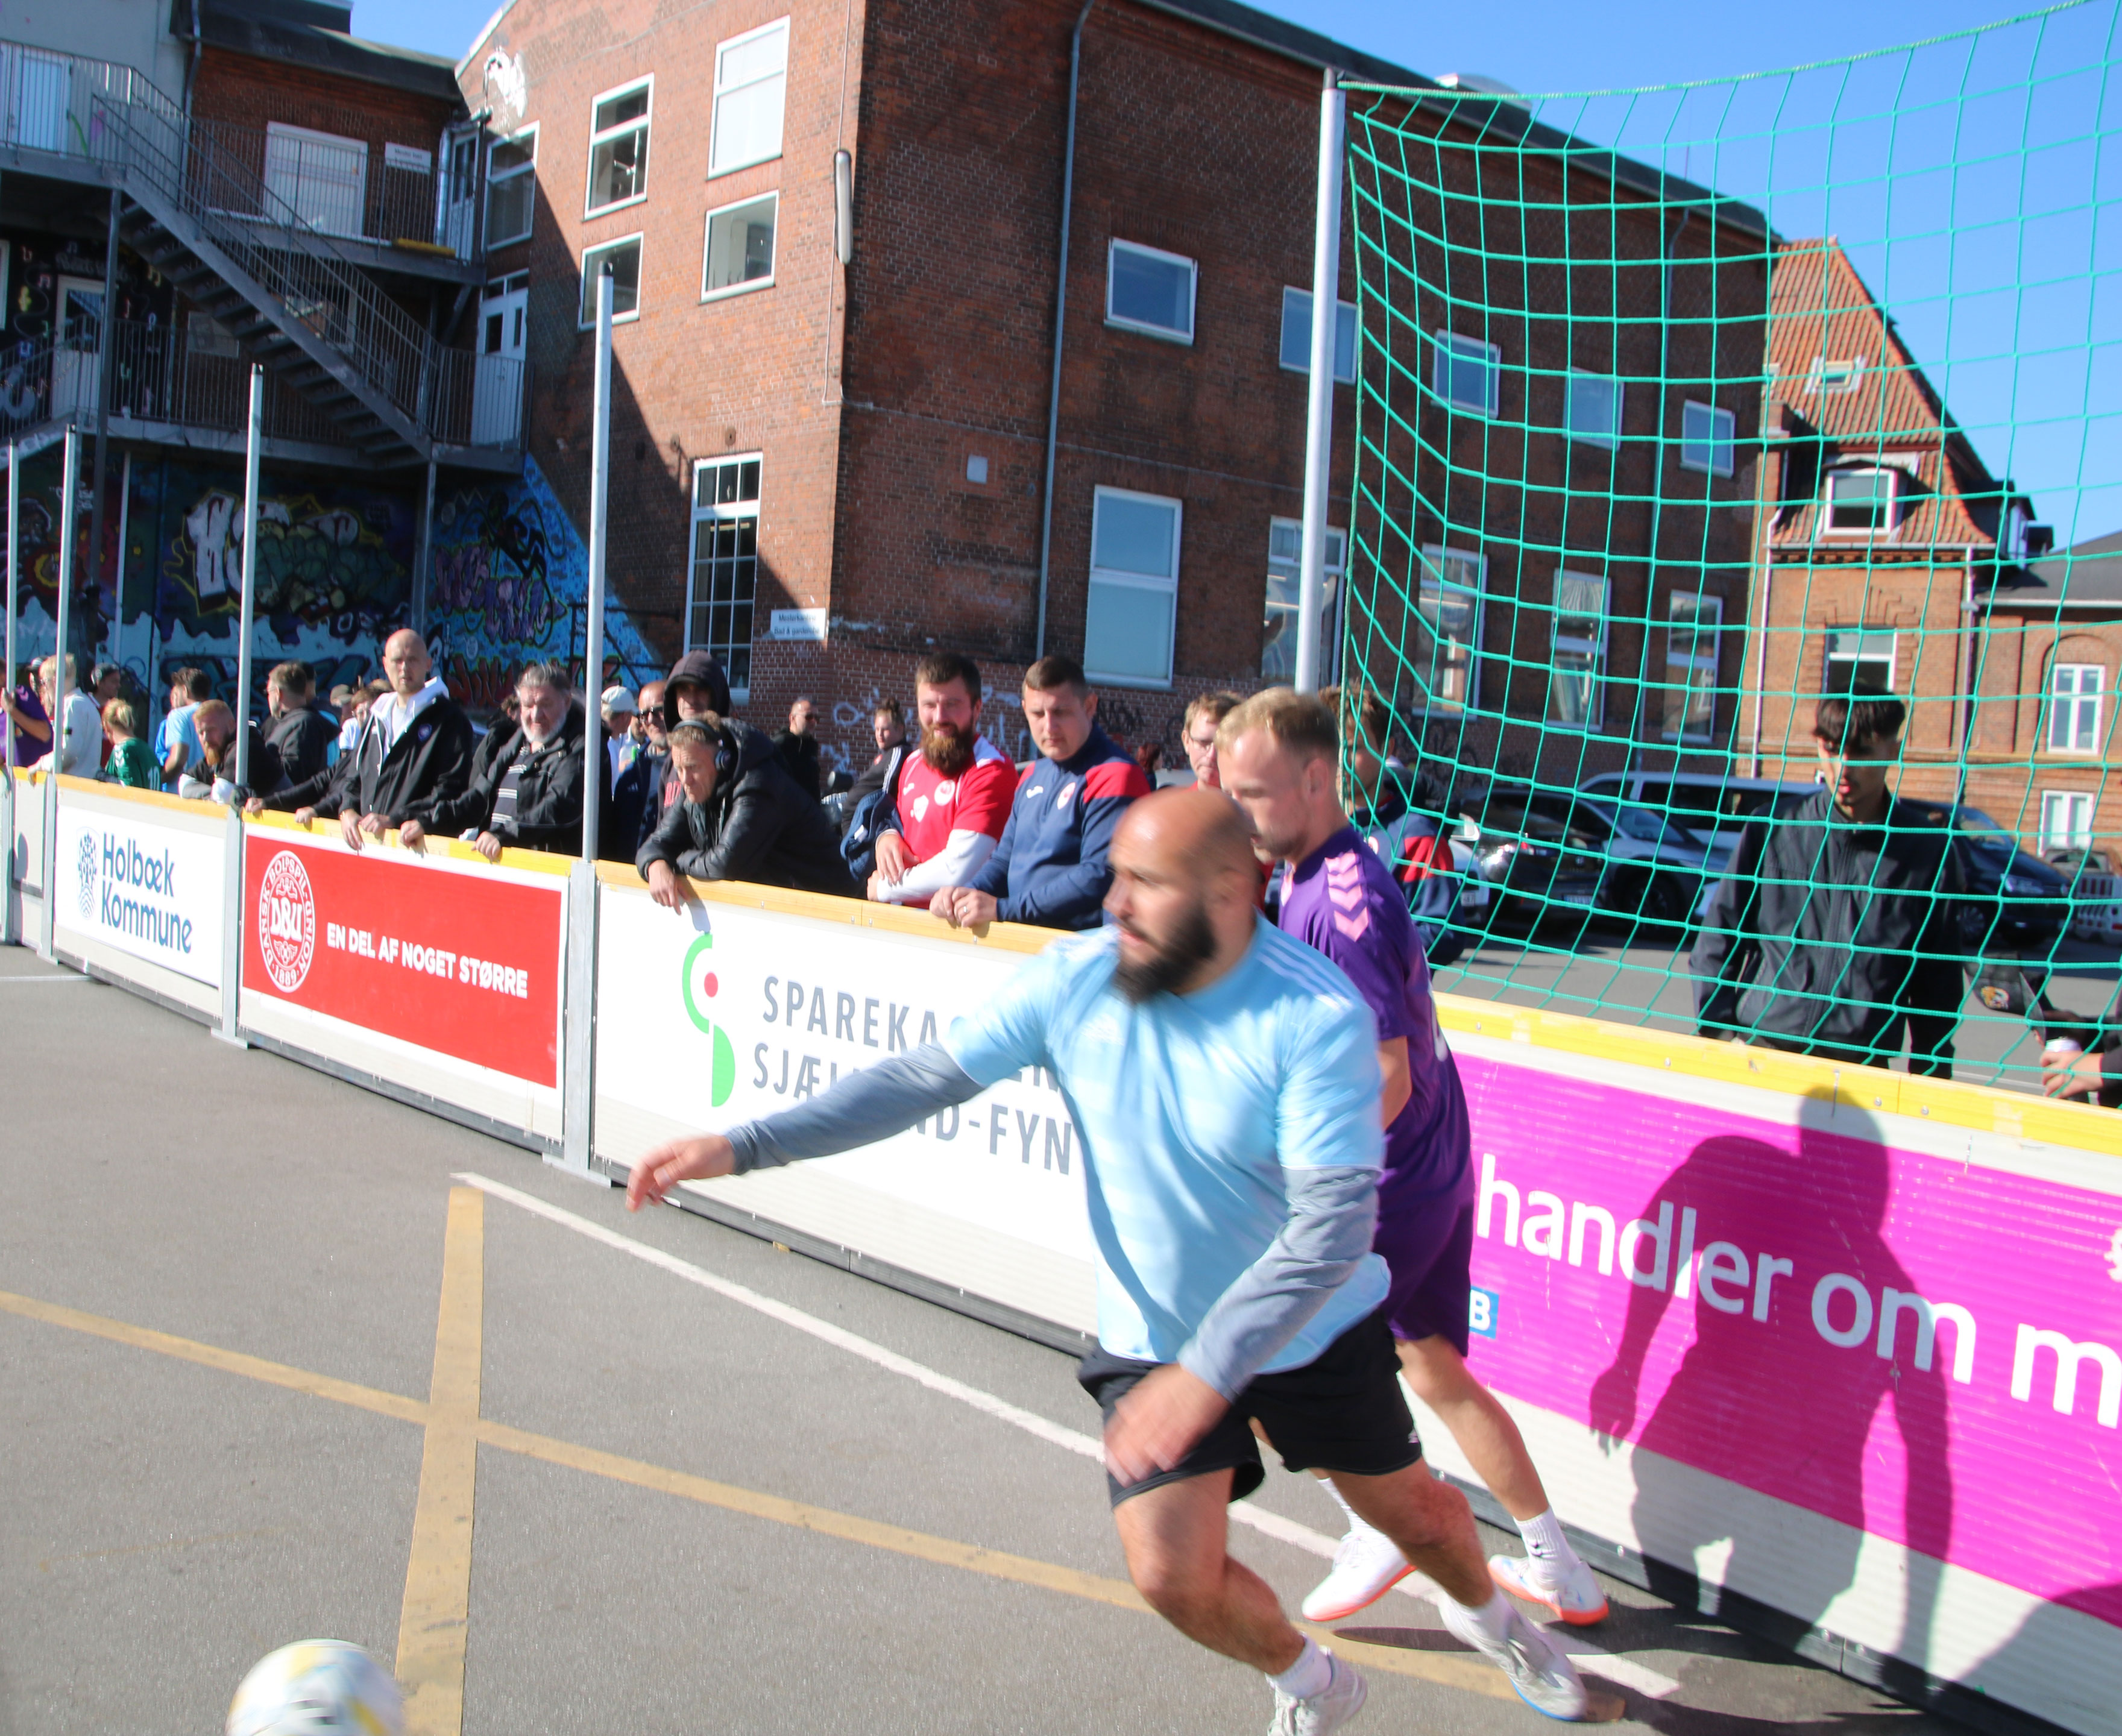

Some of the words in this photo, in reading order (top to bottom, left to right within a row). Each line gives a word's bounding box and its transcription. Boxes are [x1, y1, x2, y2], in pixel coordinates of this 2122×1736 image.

[103, 831, 175, 898] Holbæk
[101, 879, 192, 954] Kommune
[270, 896, 303, 943] DBU
[274, 964, 297, 987] 1889
[327, 922, 346, 951] EN
[348, 927, 376, 959] DEL
[378, 935, 399, 964] AF
[401, 940, 456, 980] NOGET
[459, 955, 528, 999] STØRRE
[1476, 1153, 1793, 1322] handler
[1811, 1272, 1977, 1385] om
